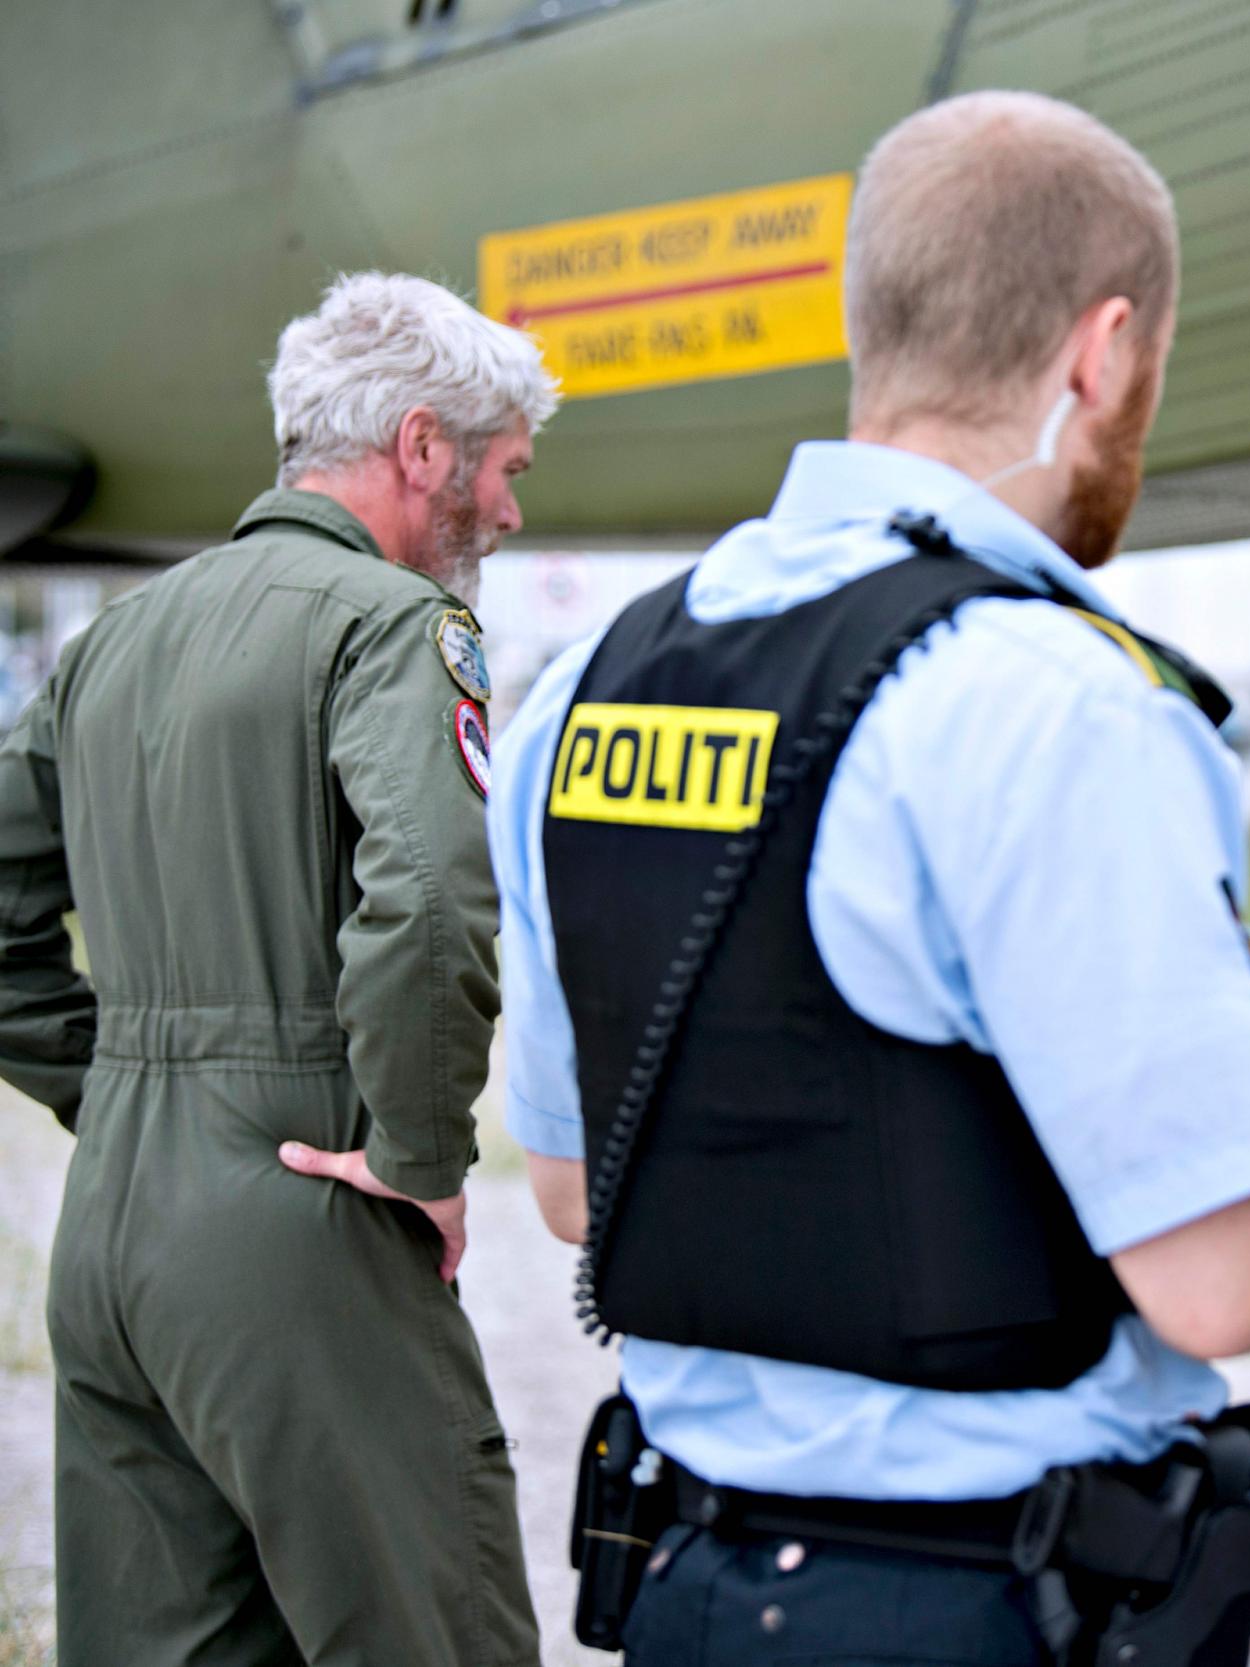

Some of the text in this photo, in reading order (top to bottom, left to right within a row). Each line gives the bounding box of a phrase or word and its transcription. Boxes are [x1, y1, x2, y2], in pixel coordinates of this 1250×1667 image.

[508, 203, 817, 288] DANGER KEEP AWAY
[561, 726, 760, 806] POLITI
